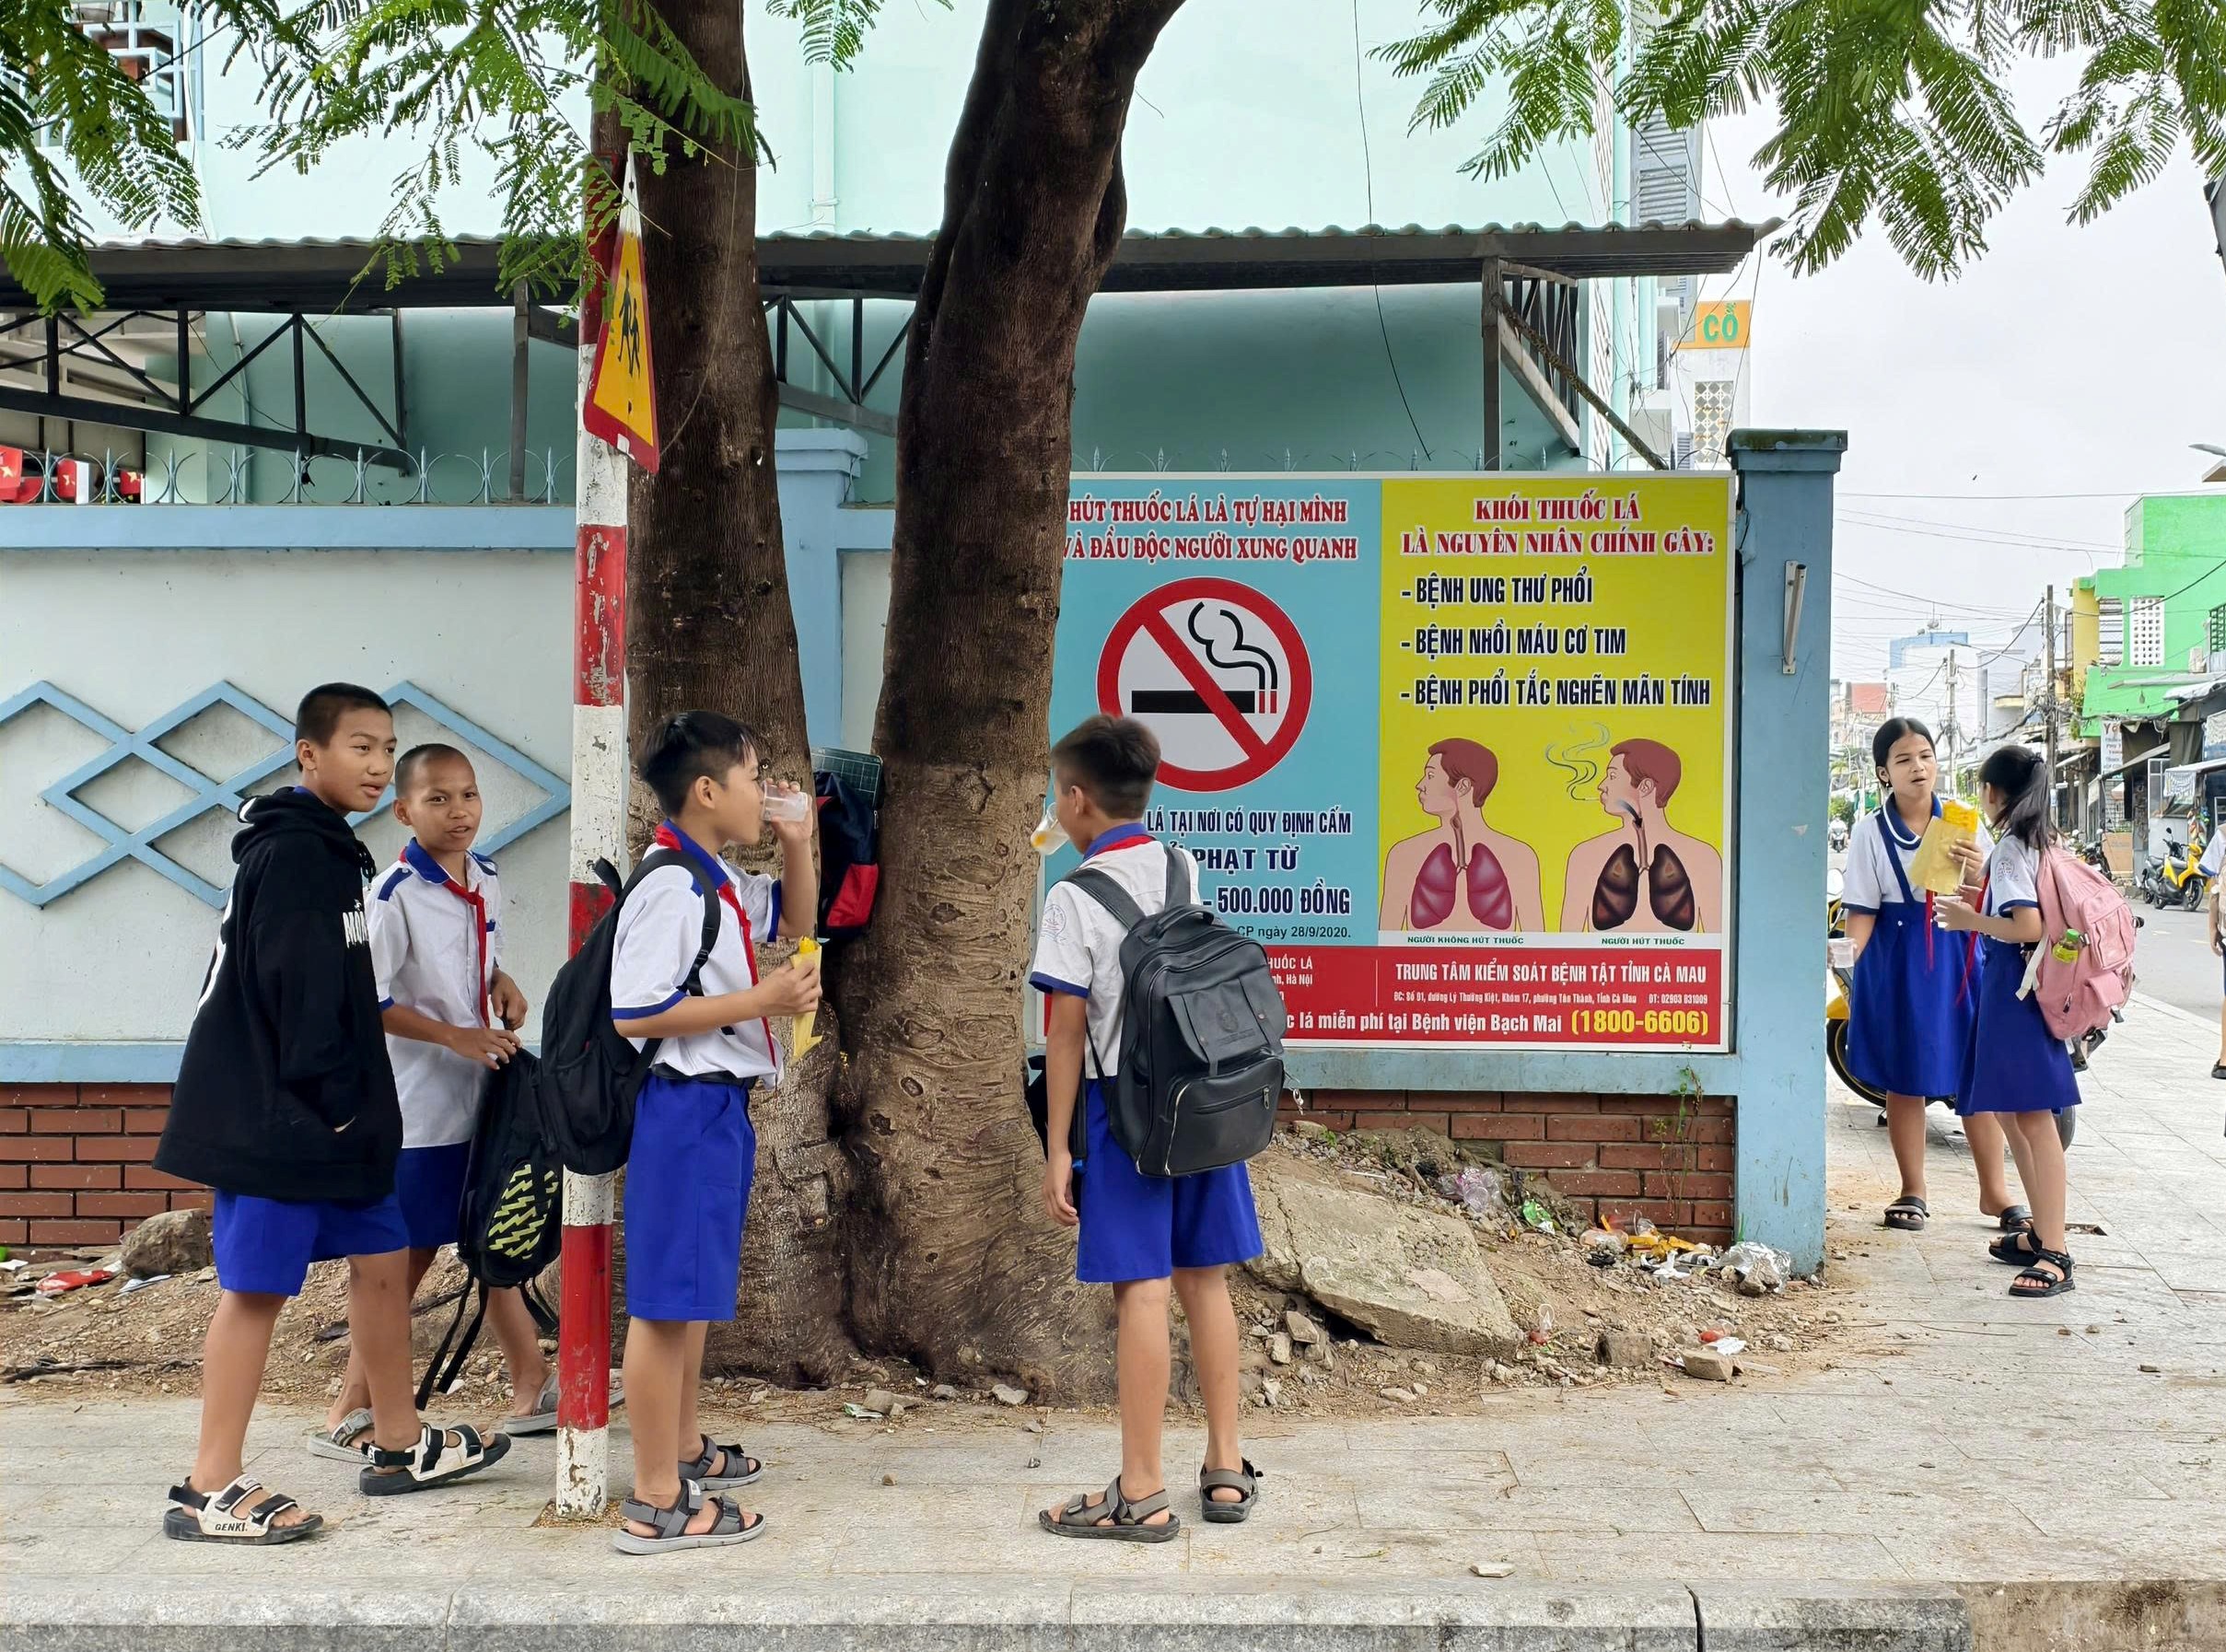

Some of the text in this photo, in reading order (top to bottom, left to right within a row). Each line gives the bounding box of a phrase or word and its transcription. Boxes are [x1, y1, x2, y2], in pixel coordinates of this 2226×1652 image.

[1069, 490, 1347, 527] HÚT THUỐC LÁ LÀ TỰ HẠI MÌNH
[1475, 489, 1640, 519] KHÓI THUỐC LÁ
[1090, 526, 1129, 558] ĐẦU
[1134, 530, 1171, 564] ĐỘC
[1175, 531, 1232, 559] NGƯỜI
[1237, 538, 1288, 559] XUNG
[1292, 538, 1358, 563] QUANH
[1403, 527, 1714, 553] LÀ NGUYÊN NHÂN CHÍNH GÂY:
[1416, 573, 1463, 609] BỆNH
[1470, 577, 1505, 603] UNG
[1512, 574, 1547, 602] THƯ
[1552, 565, 1592, 602] PHỔI
[1416, 623, 1463, 659] BỆNH
[1469, 618, 1510, 654] NHỒI
[1517, 623, 1557, 654] MÁU
[1565, 625, 1588, 654] CƠ
[1594, 629, 1626, 654] TIM
[1416, 674, 1463, 710] BỆNH
[1468, 668, 1509, 704] PHỔI
[1516, 669, 1550, 704] TẮC
[1556, 674, 1615, 704] NGHẼN
[1623, 674, 1664, 704] MÃN
[1671, 674, 1710, 704] TÍNH
[1148, 806, 1351, 838] LÁ TẠI NƠI CÓ QUY ĐỊNH CẤM
[1192, 844, 1300, 874] PHẠT TỪ
[1218, 887, 1293, 913] 500.000
[1300, 878, 1350, 913] ĐỒNG
[1258, 926, 1287, 939] ngày
[1291, 926, 1351, 937] 28/9/2020.
[1438, 936, 1469, 944] KHÔNG
[1472, 936, 1490, 944] HÚT
[1632, 937, 1650, 945] HÚT
[1267, 954, 1313, 970] HUỐC LÁ
[1395, 958, 1707, 985] TRUNG TÂM KIỂM SOÁT BỆNH TẬT TỈNH CÀ MAU
[1287, 974, 1297, 984] Hà
[1299, 974, 1312, 986] Nội
[1299, 1012, 1313, 1029] lá
[1318, 1009, 1356, 1030] miễn
[1360, 1012, 1383, 1031] phí
[1388, 1013, 1407, 1033] tại
[1413, 1013, 1450, 1034] Bệnh
[1454, 1013, 1486, 1034] viện
[1491, 1014, 1529, 1034] Bạch
[1533, 1015, 1562, 1032] Mai
[1571, 1009, 1708, 1036] (1800-6606)
